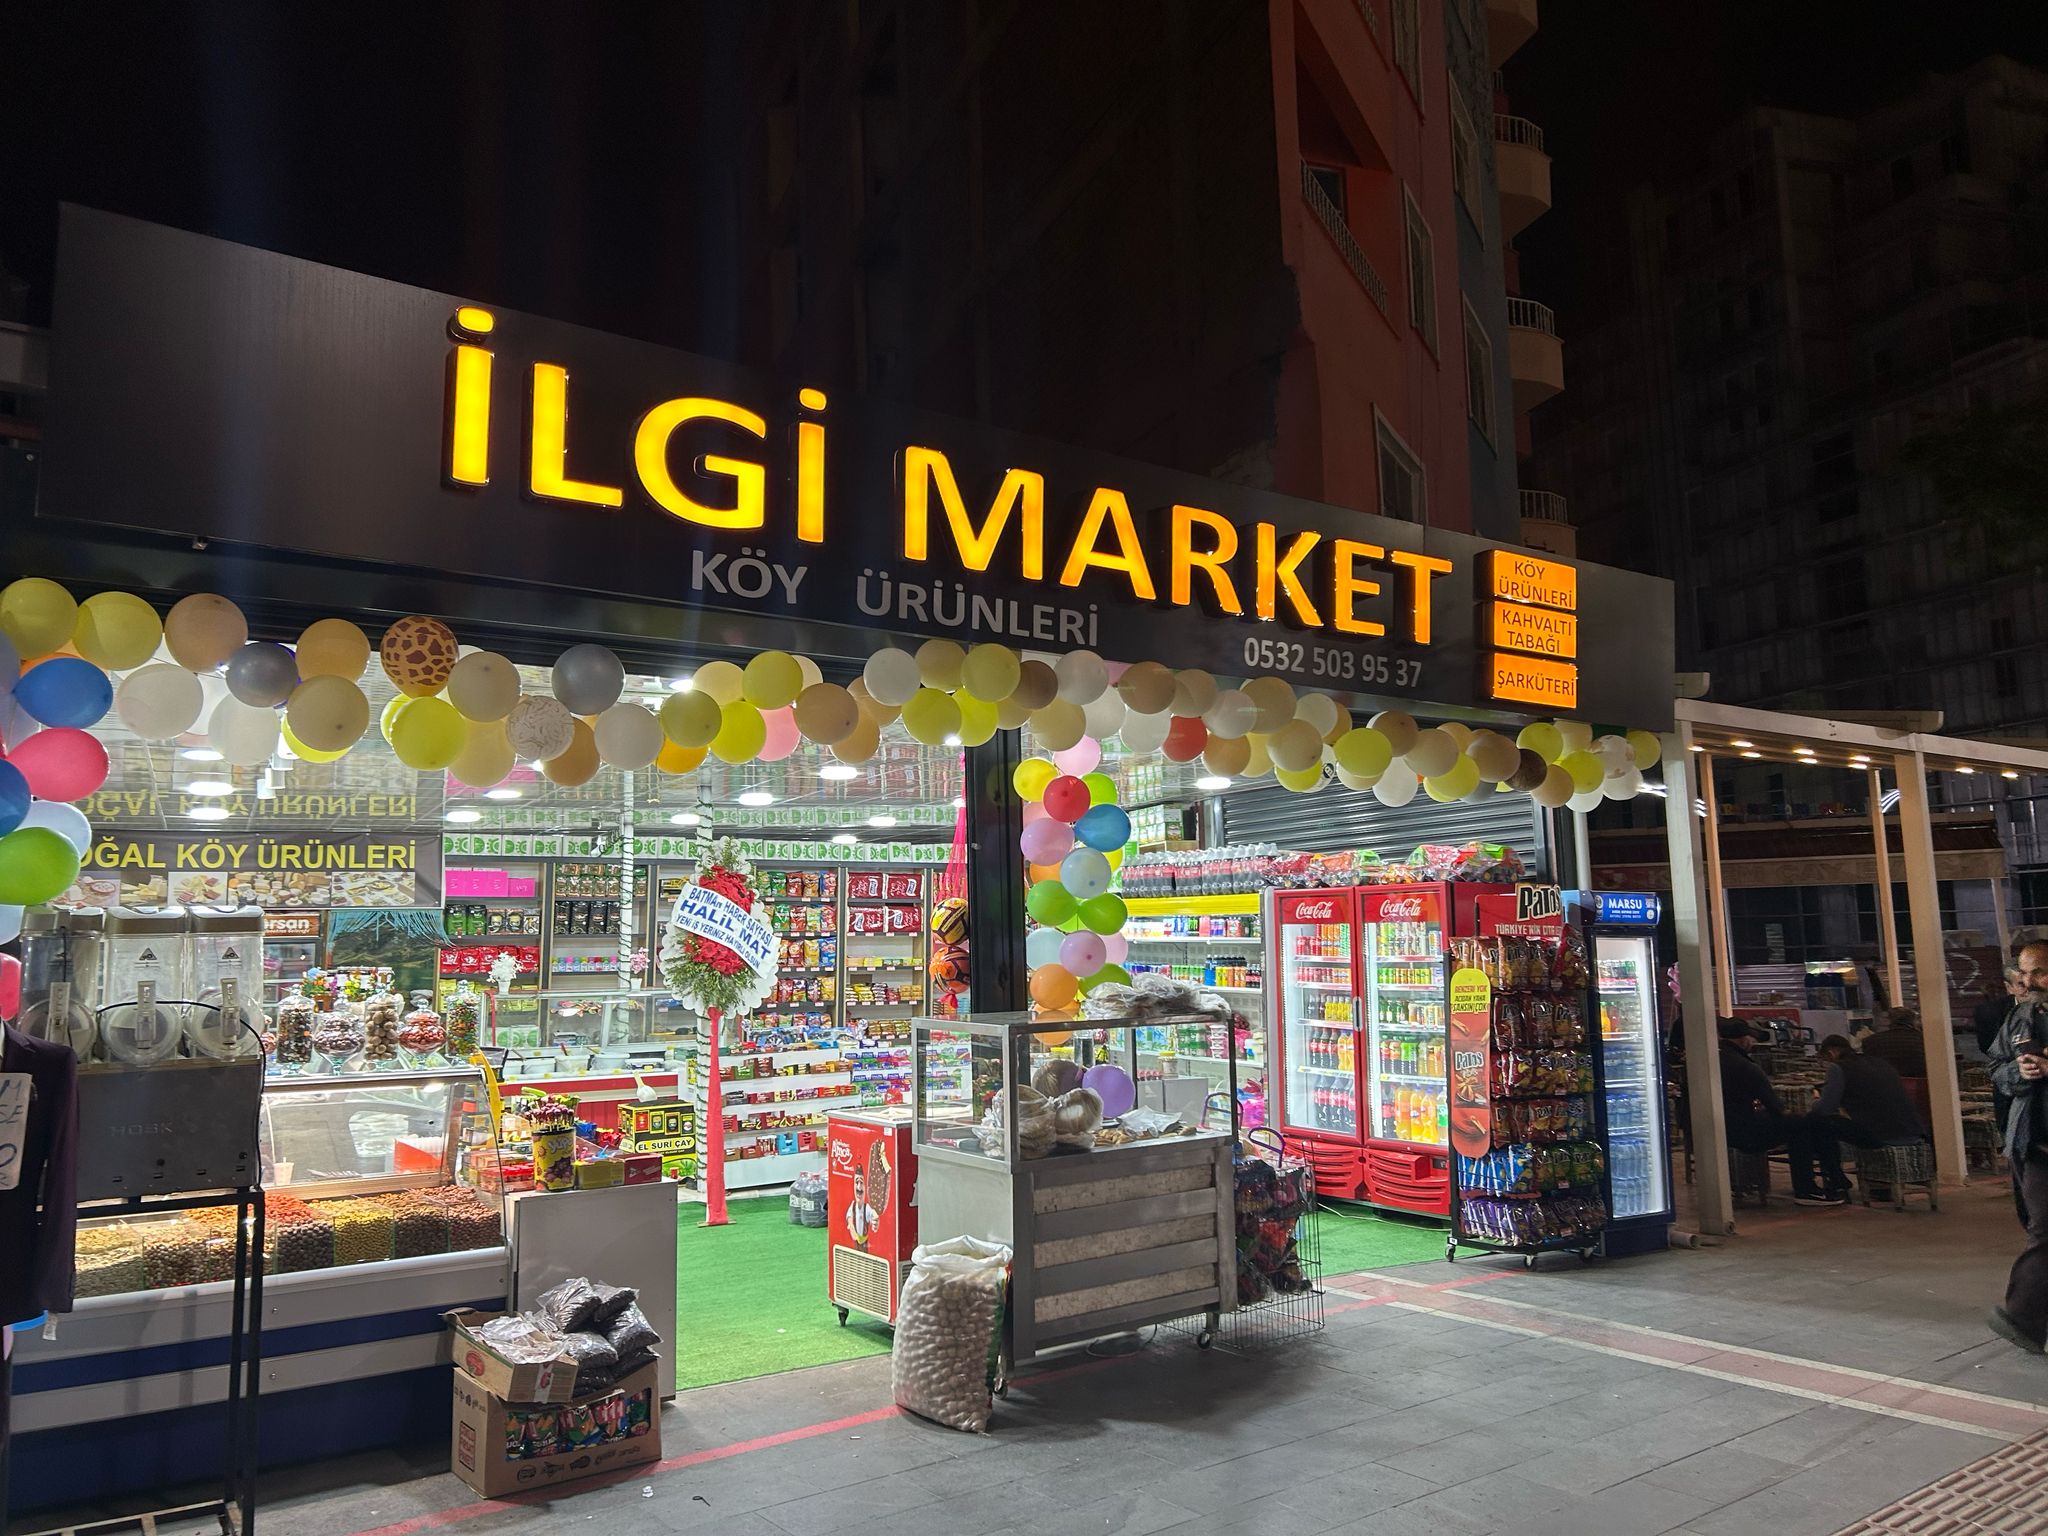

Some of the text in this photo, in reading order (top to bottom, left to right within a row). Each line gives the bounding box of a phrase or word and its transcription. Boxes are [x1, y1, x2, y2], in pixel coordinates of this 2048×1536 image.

[450, 304, 1454, 646] İLGİ MARKET
[1514, 560, 1545, 580] KÖY
[691, 546, 1099, 647] KÖY ÜRÜNLERİ
[1499, 575, 1573, 608] ÜRÜNLERİ
[1502, 608, 1572, 636] KAHVALTI
[1507, 630, 1560, 654] TABAĞI
[1243, 637, 1422, 688] 0532 503 95 37
[1497, 669, 1575, 697] ŞARKÜTERİ
[176, 838, 248, 869] KÖY
[257, 839, 416, 869] ÜRÜNLERİ
[1608, 898, 1643, 910] MARSU
[739, 928, 771, 960] MAT
[674, 1139, 692, 1149] ÇAY
